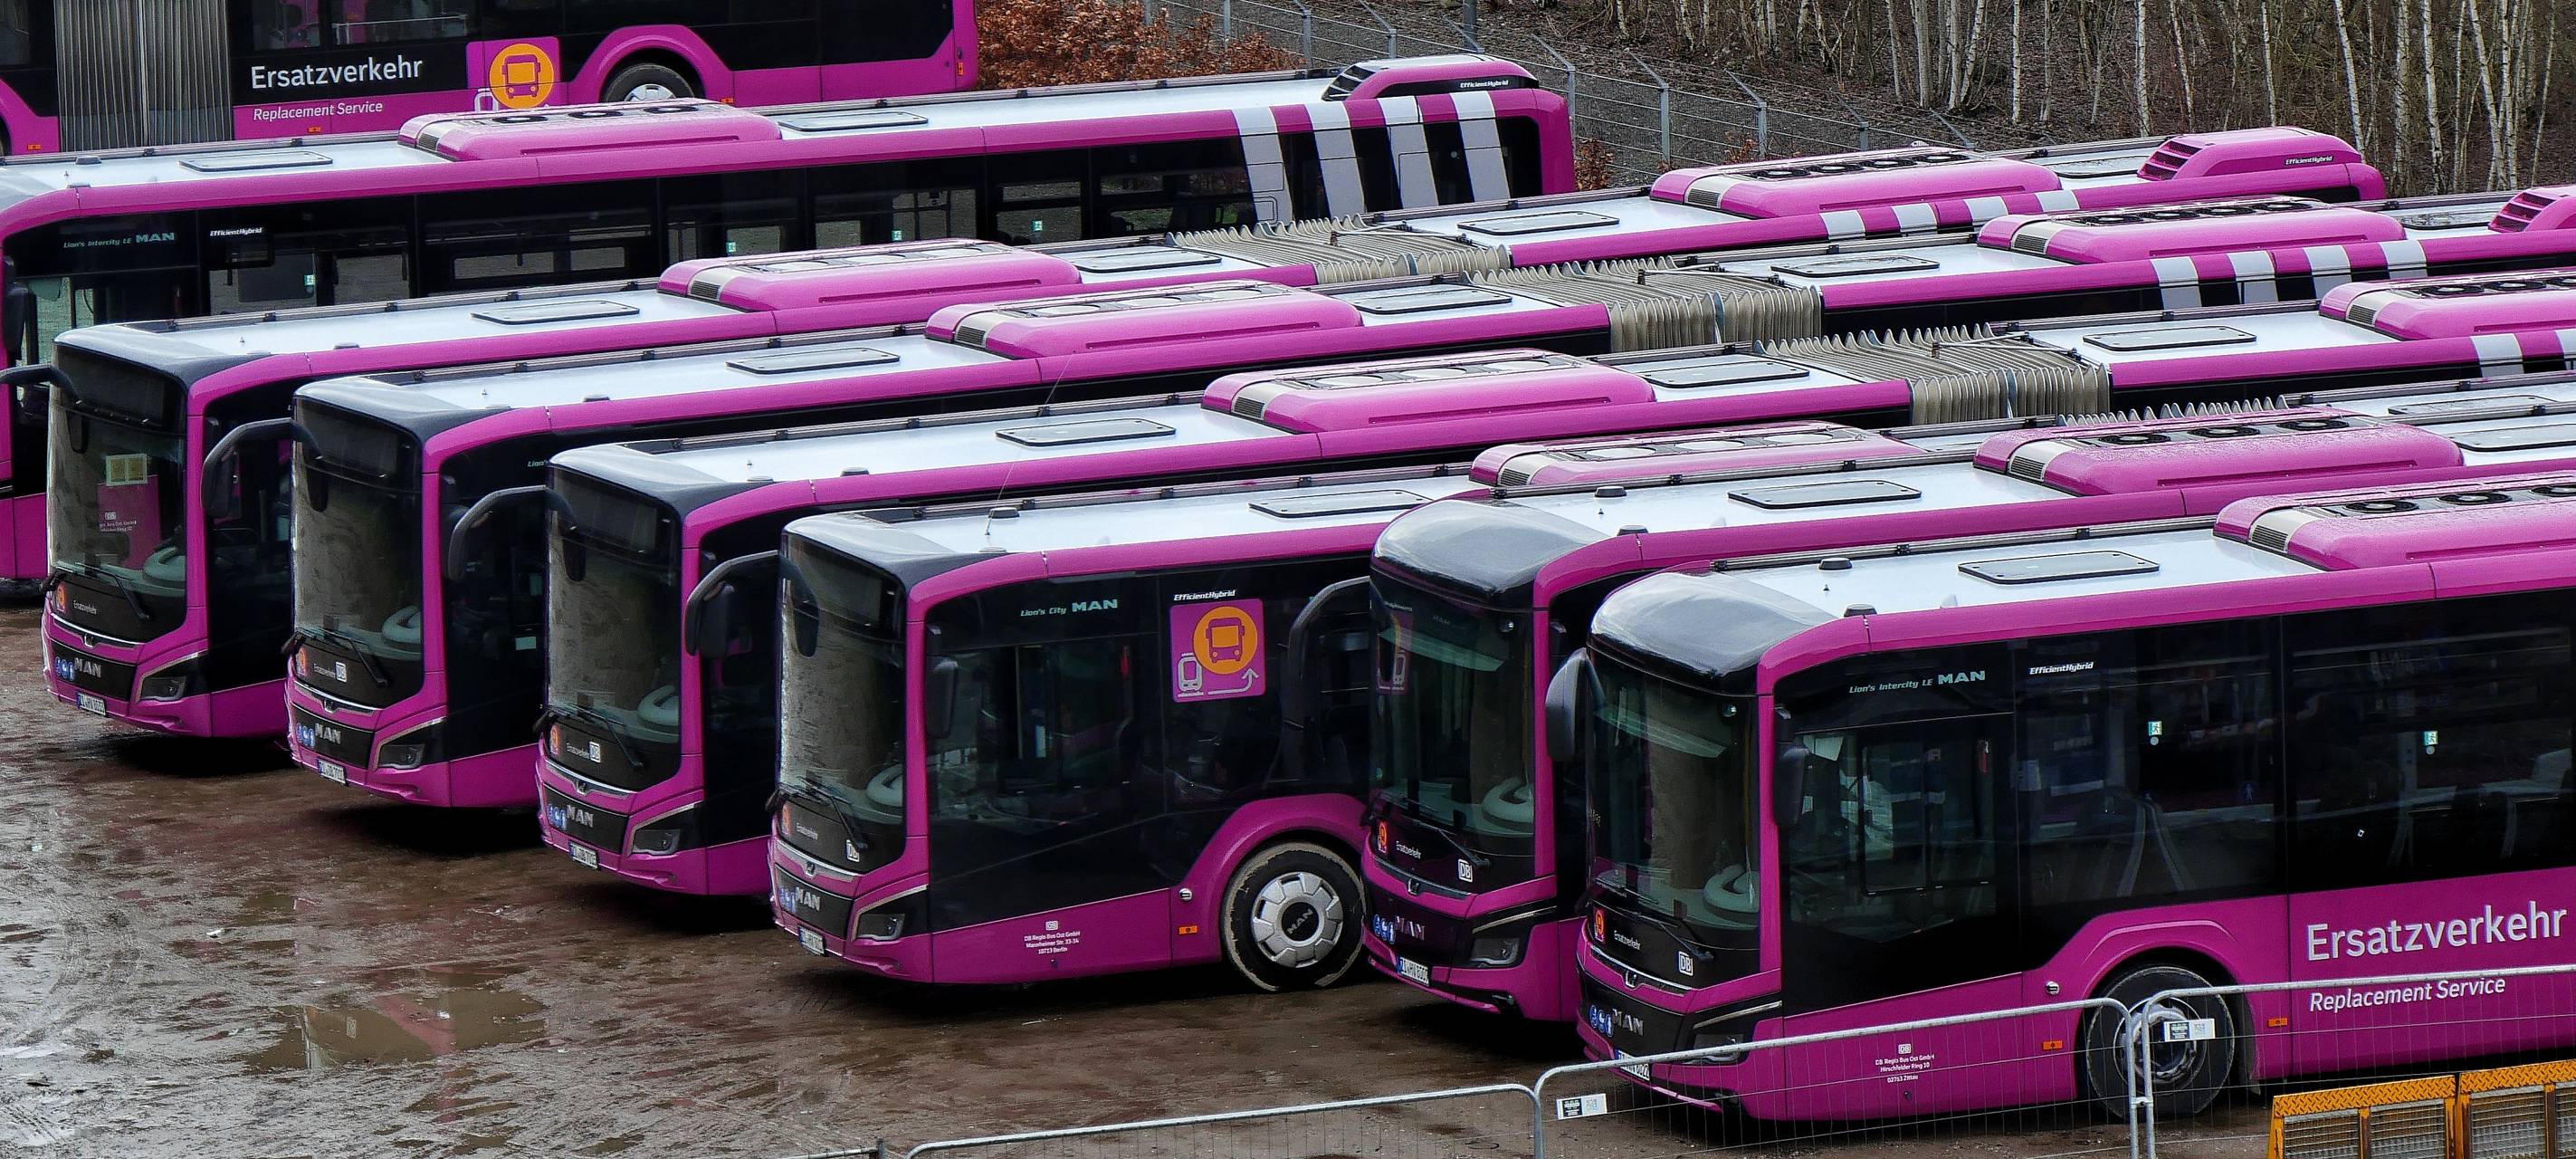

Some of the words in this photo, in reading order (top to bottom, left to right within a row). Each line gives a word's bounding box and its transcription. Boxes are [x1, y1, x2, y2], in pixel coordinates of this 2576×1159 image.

[252, 54, 423, 89] Ersatzverkehr
[253, 104, 334, 121] Replacement
[337, 101, 383, 115] Service
[136, 232, 175, 244] MAN
[209, 227, 263, 236] EfficientHybrid
[88, 238, 120, 247] Intercity
[1173, 589, 1236, 601] EfficientHybrid
[1020, 608, 1045, 617] Lion's
[1049, 606, 1067, 615] City
[1072, 599, 1118, 613] MAN
[74, 656, 101, 678] MAN
[1938, 670, 1986, 685] MAN
[2029, 661, 2094, 675] EfficientHybrid
[1849, 684, 1875, 694] Lion's
[1879, 680, 1919, 691] Intercity
[1922, 678, 1933, 686] LE
[315, 723, 341, 744] MAN
[567, 804, 594, 828] MAN
[1459, 860, 1472, 881] DB
[796, 886, 821, 912] MAN
[1287, 908, 1314, 934] MAN
[1395, 915, 1425, 941] MAN
[2307, 900, 2568, 962] Ersatzverkehr
[1679, 952, 1693, 974] DB
[2310, 982, 2432, 1013] Replacement
[2437, 978, 2506, 1000] Service
[1612, 1008, 1645, 1037] MAN
[1919, 1053, 1935, 1061] GmbH
